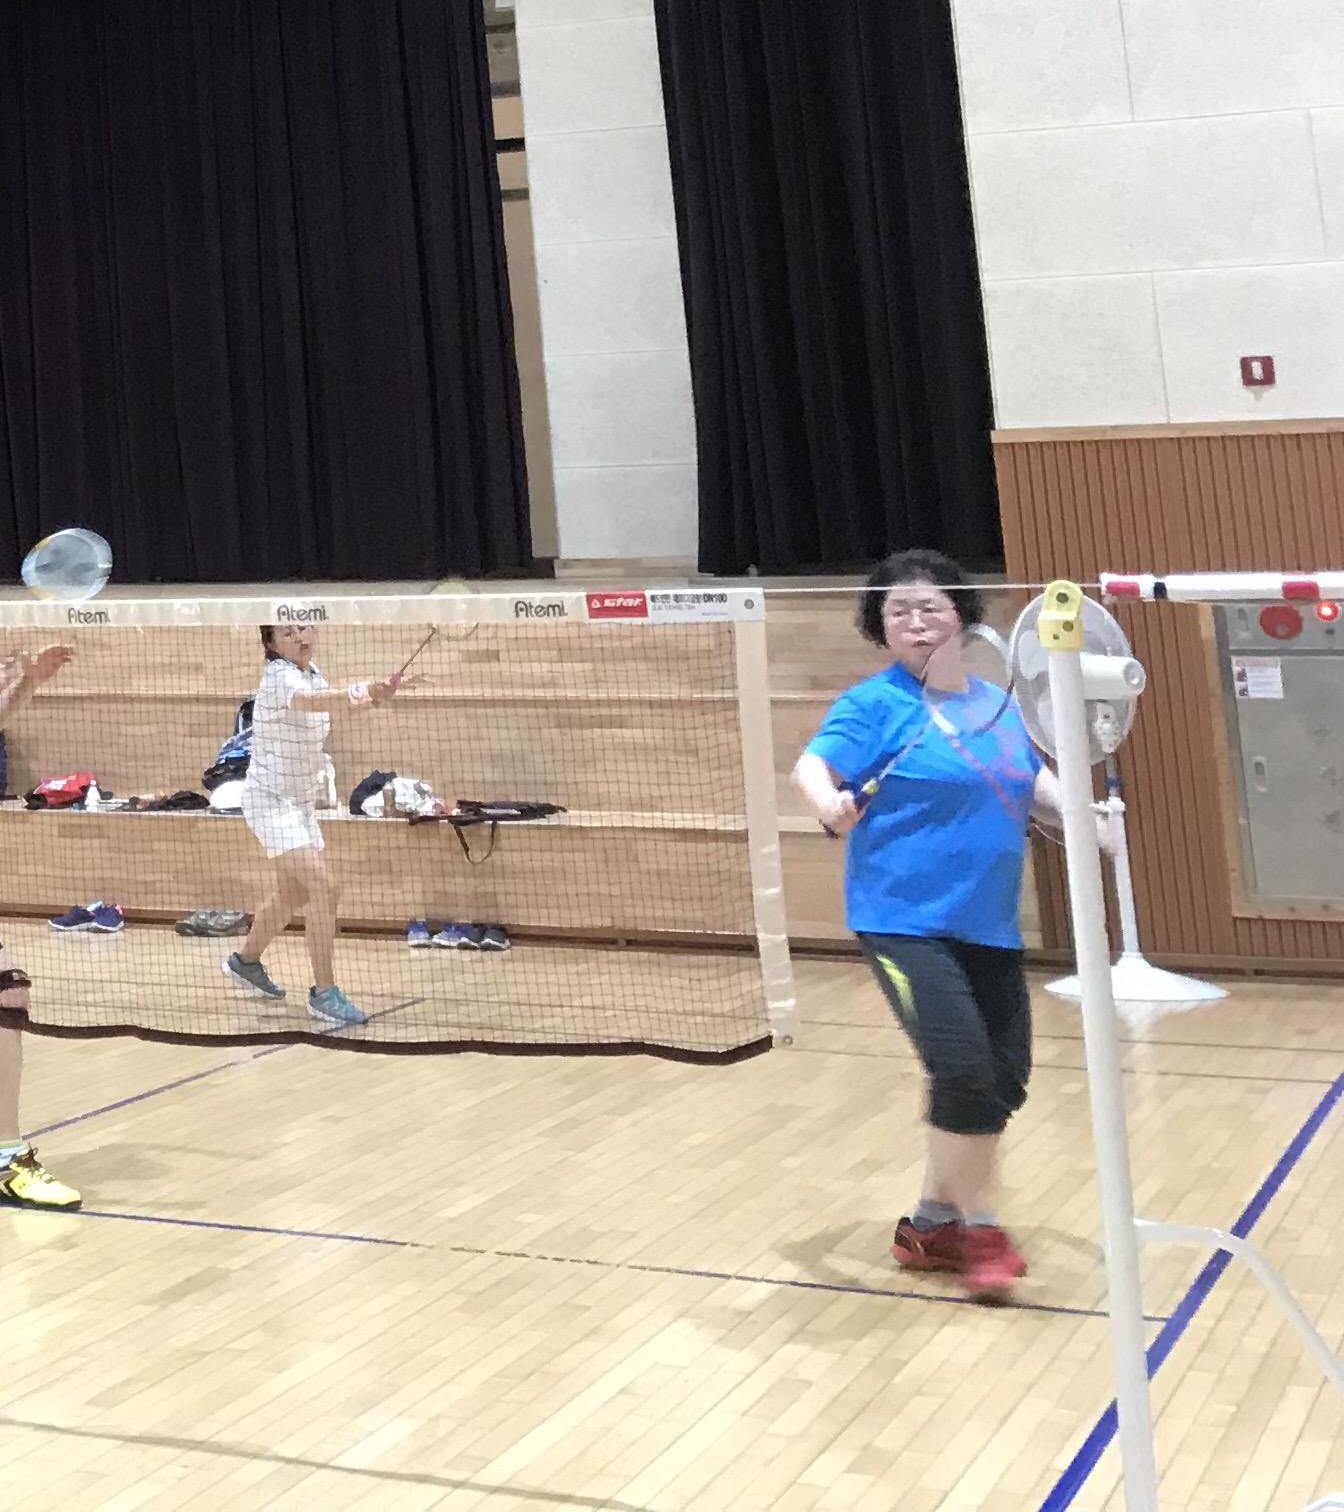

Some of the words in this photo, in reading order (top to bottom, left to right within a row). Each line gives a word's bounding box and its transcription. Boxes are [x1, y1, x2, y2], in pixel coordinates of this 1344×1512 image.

[67, 606, 110, 624] Atemi
[276, 603, 328, 622] Atemi
[514, 599, 567, 618] Atemi
